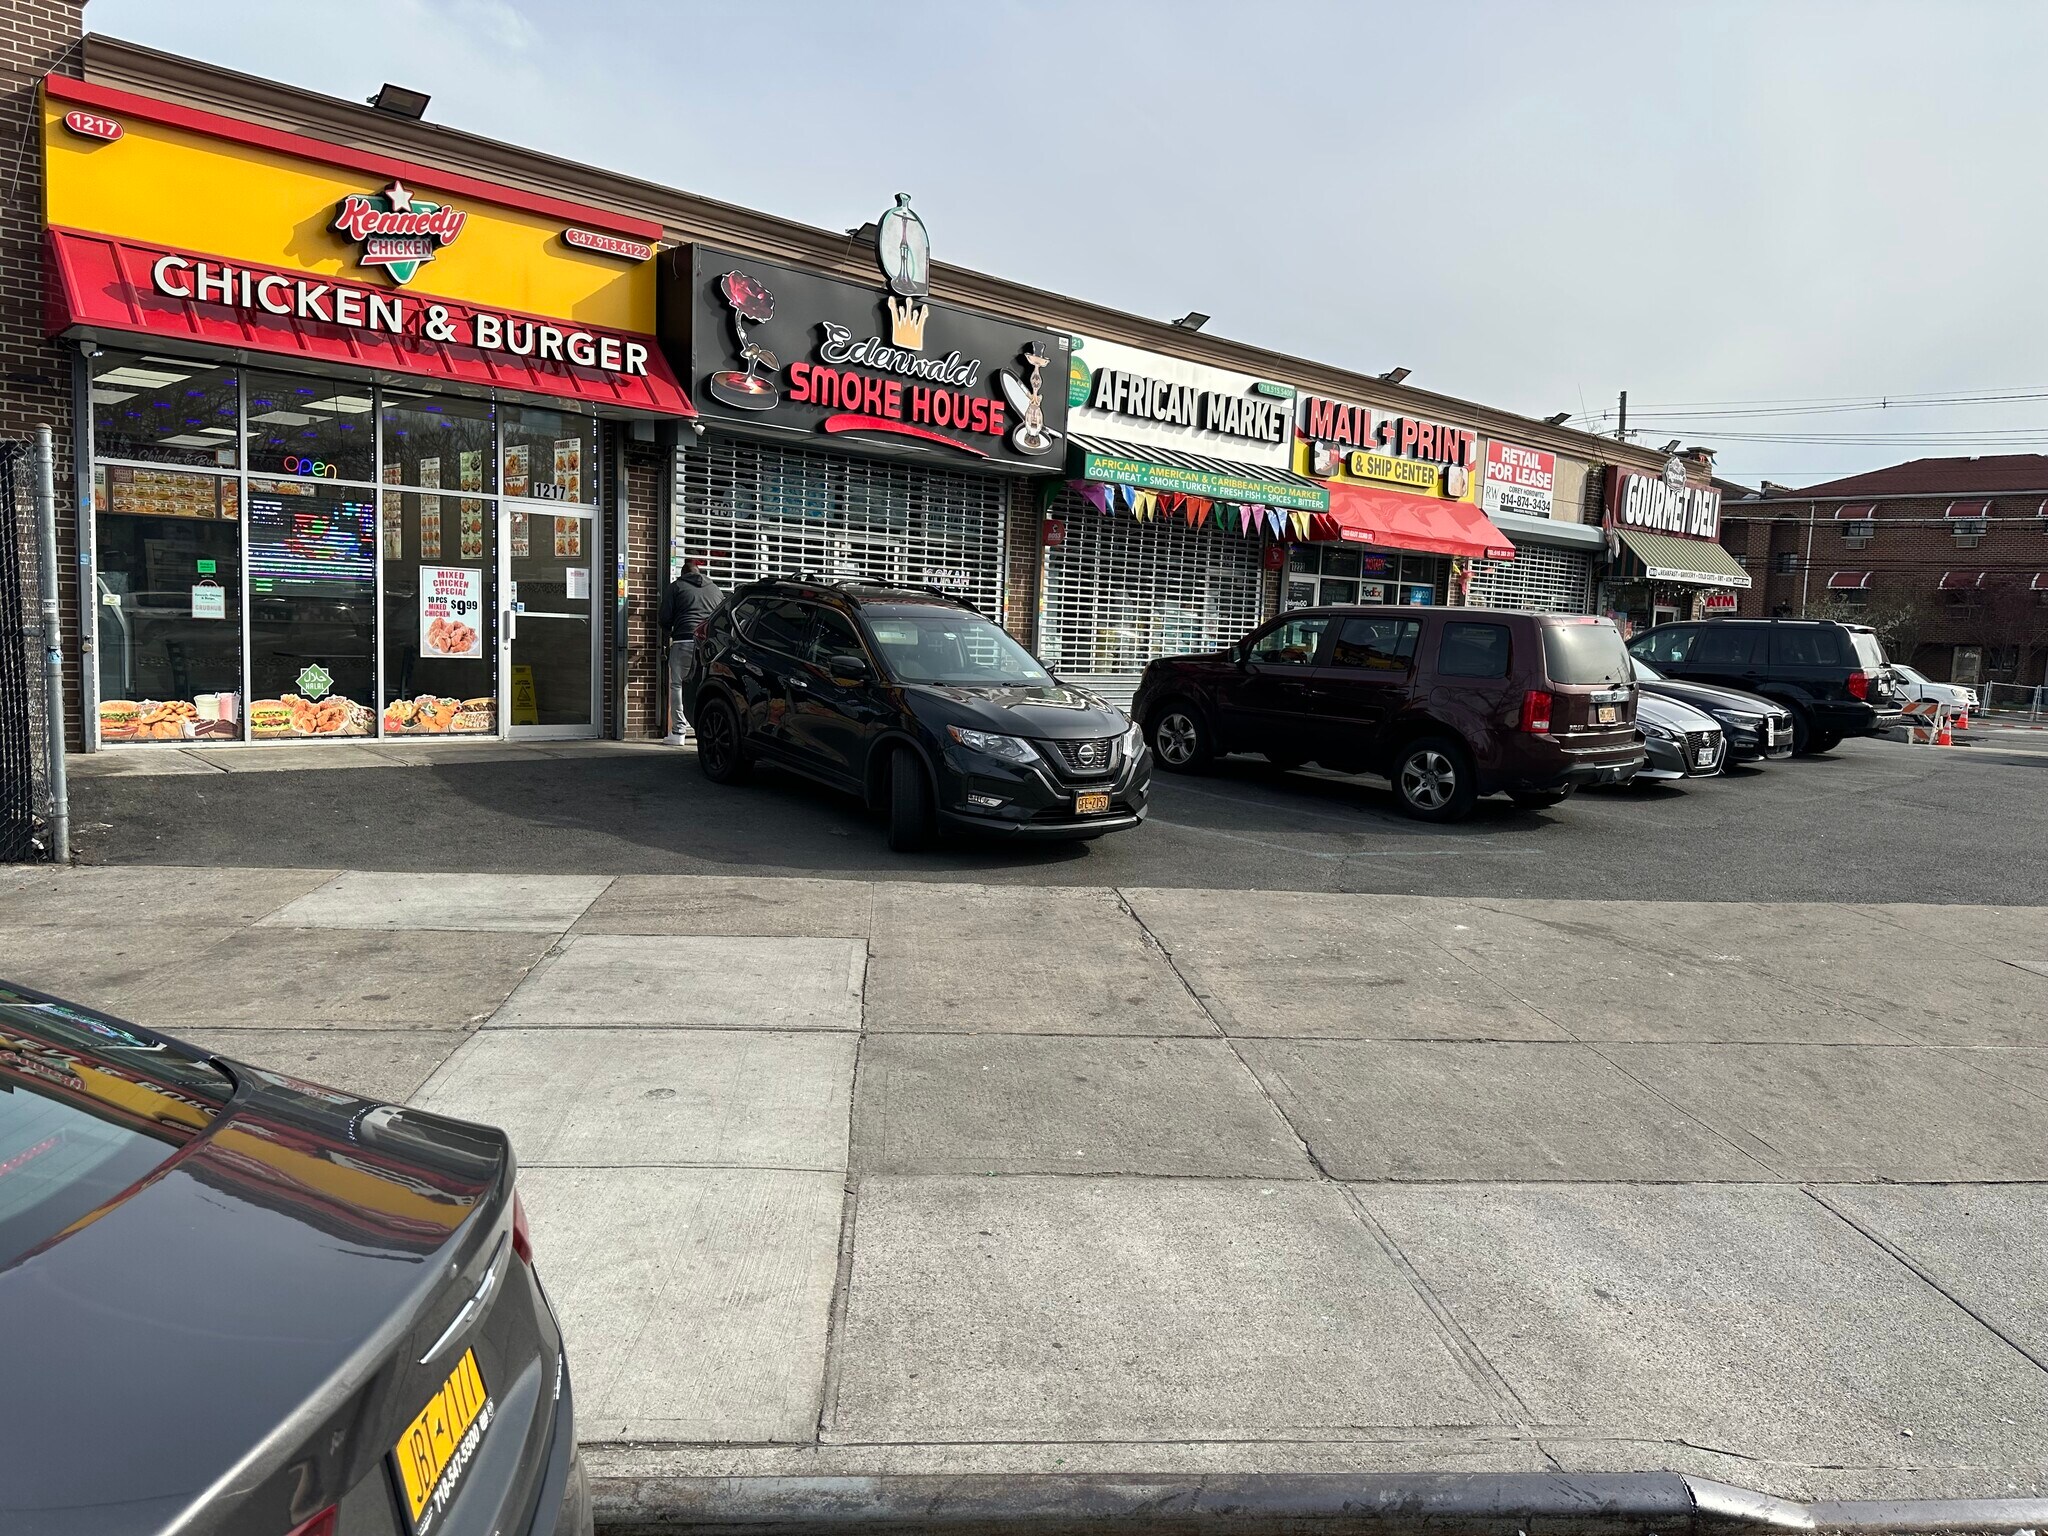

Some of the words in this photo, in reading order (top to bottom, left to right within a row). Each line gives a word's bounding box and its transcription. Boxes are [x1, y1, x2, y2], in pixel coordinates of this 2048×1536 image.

[72, 113, 118, 136] 1217
[335, 198, 467, 246] Kennedy
[368, 239, 432, 255] CHICKEN
[572, 231, 649, 258] 347.913.4122
[154, 256, 403, 335] CHICKEN
[425, 305, 459, 343] &
[476, 313, 649, 377] BURGER
[820, 321, 981, 388] Edenwald
[790, 362, 902, 419] SMOKE
[912, 385, 1005, 436] HOUSE
[1094, 367, 1199, 427] AFRICAN
[1206, 391, 1295, 444] MARKET
[1309, 397, 1378, 449] MAIL
[1383, 420, 1396, 446] +
[1401, 417, 1477, 467] PRINT
[1355, 454, 1364, 473] &
[1367, 455, 1392, 478] SHIP
[1394, 461, 1435, 485] CENTER
[1501, 446, 1542, 471] RETAIL
[1093, 458, 1139, 473] AFRICAN
[1148, 467, 1199, 482] AMERICAN
[1202, 475, 1209, 484] &
[1211, 476, 1261, 492] CARIBBEAN
[1262, 484, 1287, 495] FOOD
[1288, 487, 1322, 500] MARKET
[1487, 460, 1513, 482] FOR
[1515, 466, 1552, 489] LEASE
[536, 483, 566, 500] 1217
[1088, 467, 1114, 479] GOAT
[1116, 470, 1142, 483] MEAT
[1149, 478, 1180, 488] SMOKE
[1181, 480, 1212, 493] TURKEY
[1219, 487, 1243, 498] FRESH
[1244, 490, 1261, 500] FISH
[1267, 493, 1292, 505] SPICES
[1298, 497, 1325, 509] BITTERS
[1500, 492, 1551, 512] 914-874-3434
[1625, 473, 1692, 533] GOURMET
[1690, 488, 1720, 538] DELI
[433, 580, 470, 589] CHICKEN
[437, 571, 465, 580] MIXED
[428, 596, 435, 604] 10
[435, 596, 448, 604] PCS
[435, 588, 467, 597] SPECIAL
[1362, 586, 1382, 598] FedEx
[1706, 595, 1735, 607] ATM
[424, 610, 451, 618] CHICKEN
[428, 603, 447, 611] MIXED
[305, 682, 325, 690] HALAL
